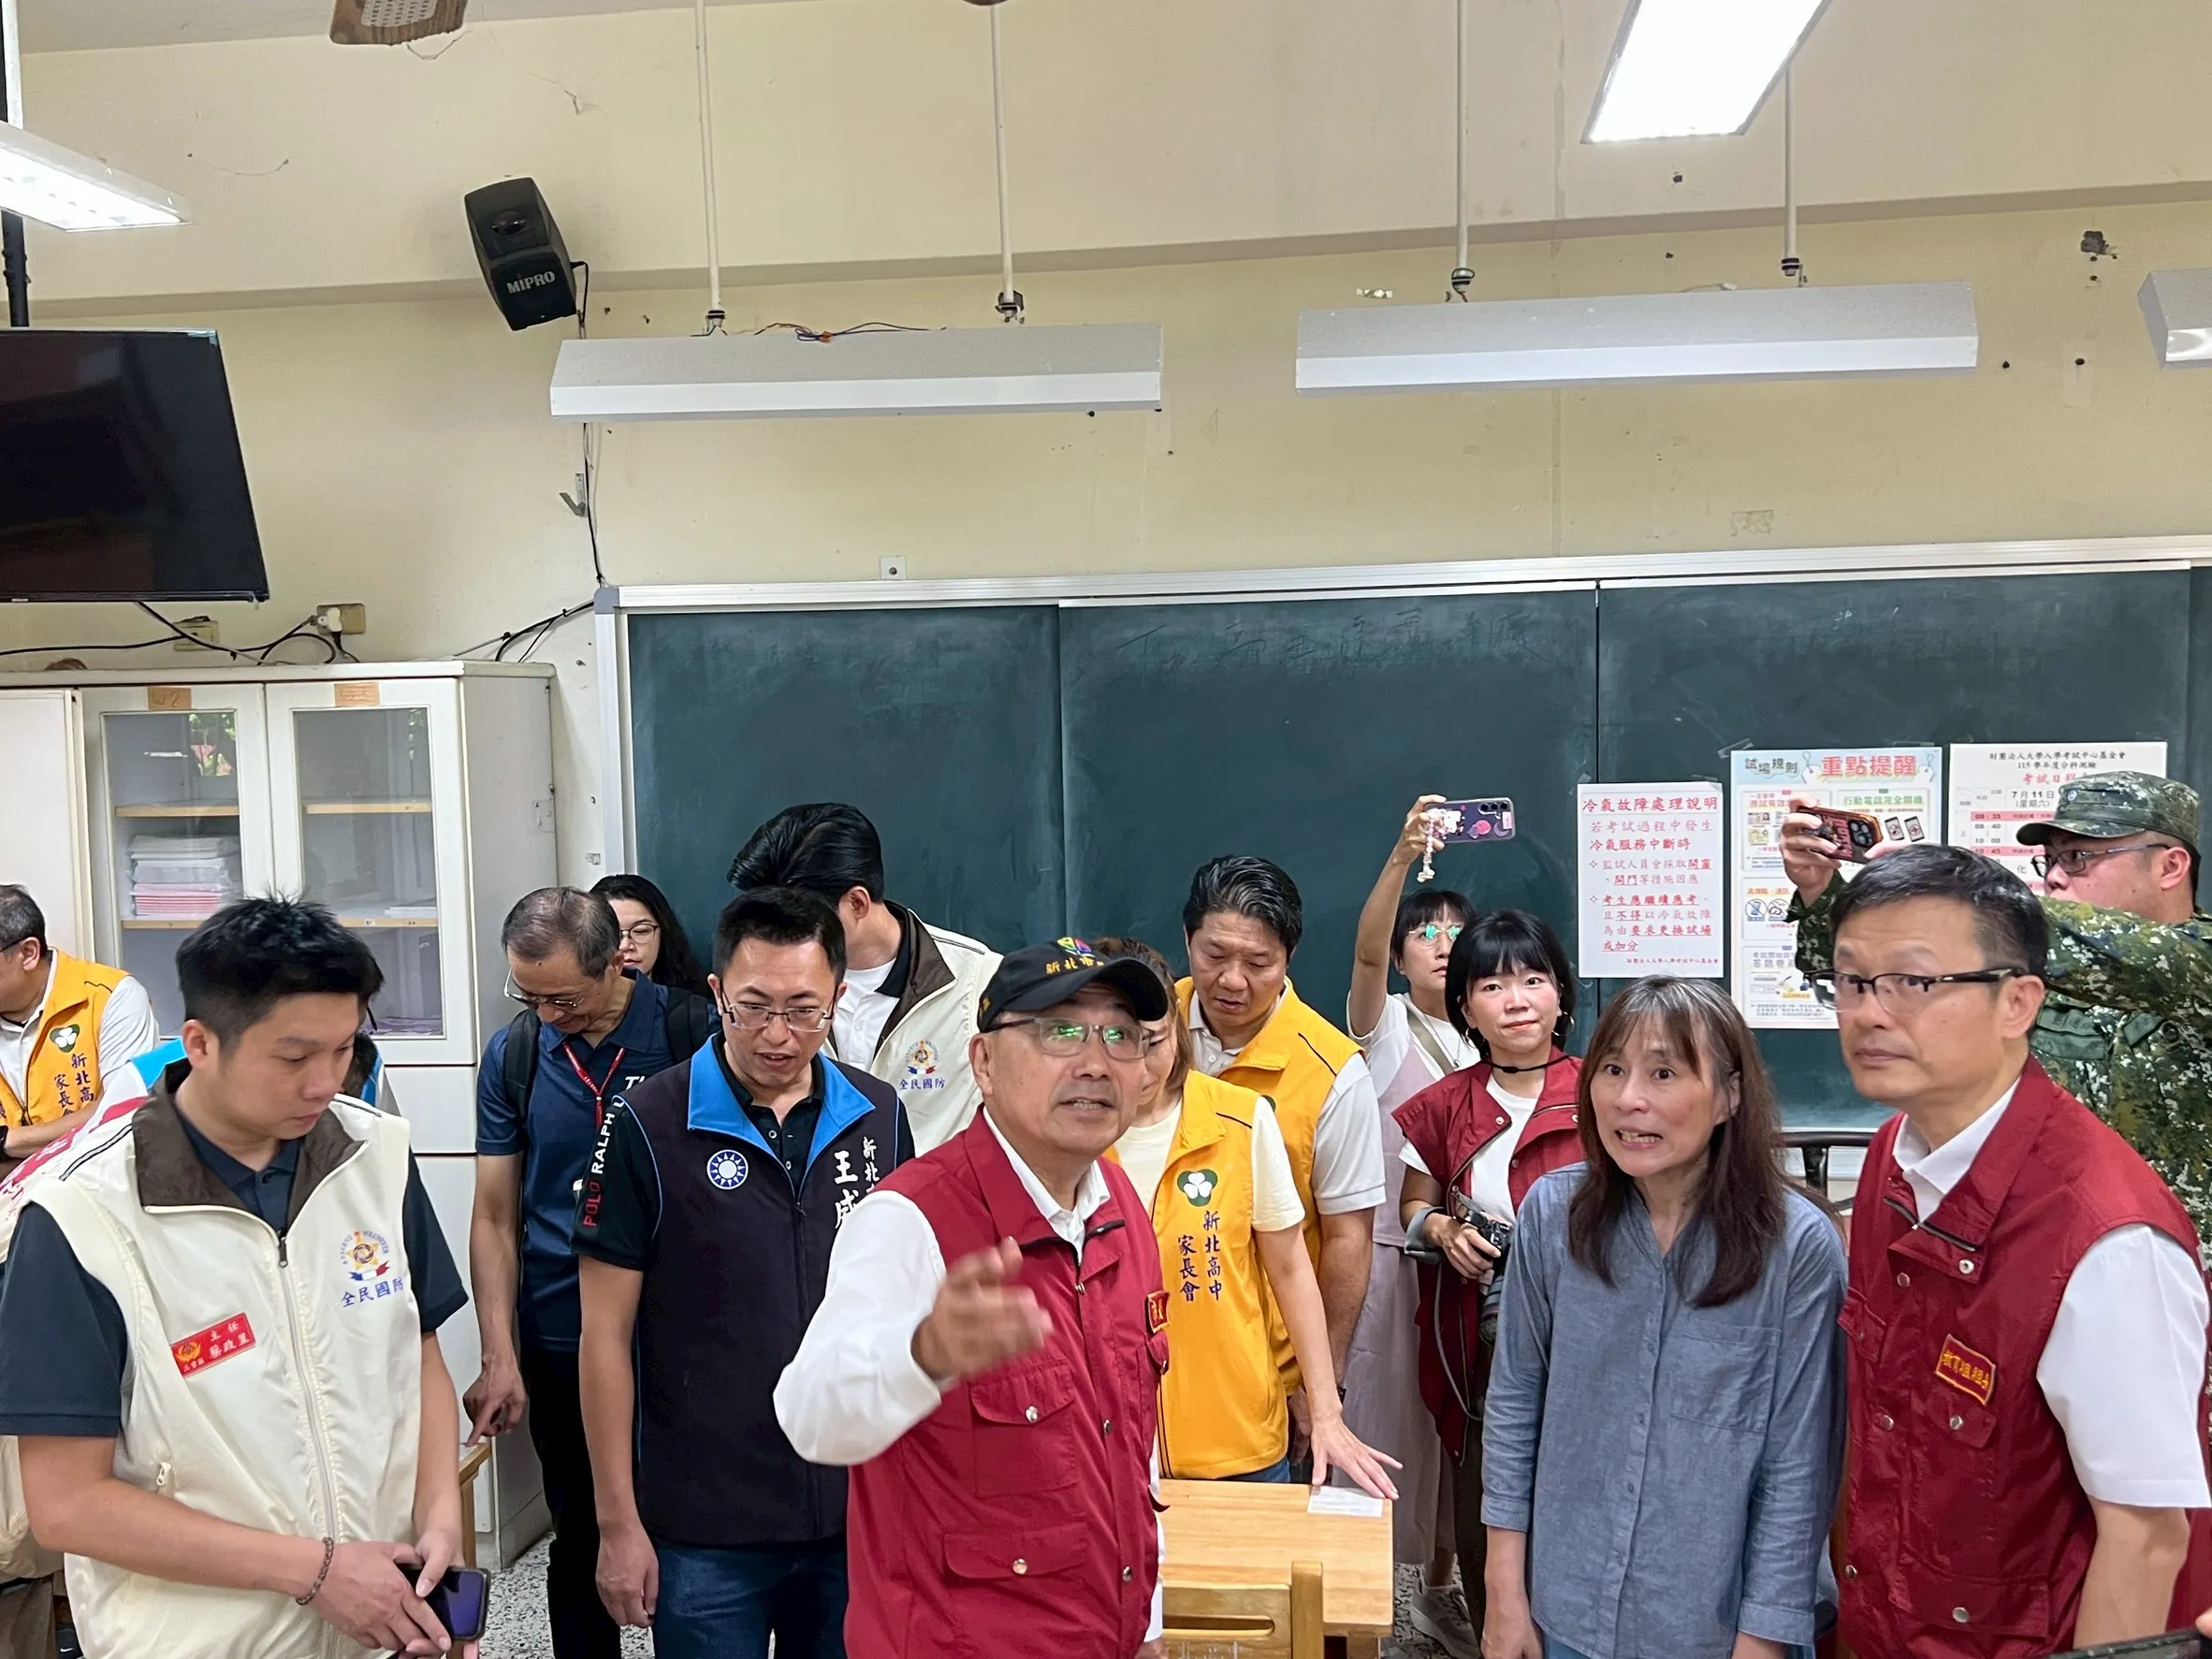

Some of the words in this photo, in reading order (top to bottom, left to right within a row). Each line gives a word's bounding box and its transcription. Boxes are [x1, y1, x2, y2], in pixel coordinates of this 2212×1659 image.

[506, 270, 556, 294] MIPRO
[1989, 751, 2126, 760] 財團法人大學入學考試中心基金會
[1744, 757, 1798, 774] 試場規則
[1820, 754, 1917, 778] 重點提醒
[2022, 772, 2088, 785] 考試日程
[1582, 796, 1718, 812] 冷氣故障處理說明
[1591, 820, 1713, 834] 若考試過程中發生
[1590, 838, 1692, 851] 冷氣服務中斷時
[1603, 909, 1711, 921] 且不得以冷氣故障
[1603, 924, 1712, 936] 為由要求更換試場
[1603, 939, 1638, 952] 或加分
[1045, 956, 1104, 974] 新北市
[899, 1077, 945, 1090] 全民國防
[591, 1112, 615, 1174] RALPH
[863, 1136, 880, 1193] 新北
[583, 1181, 601, 1227] POLO
[1202, 1210, 1222, 1301] 新北高中
[1177, 1234, 1201, 1302] 家長會
[341, 1276, 404, 1307] 全民國防
[211, 1320, 240, 1342] 主任
